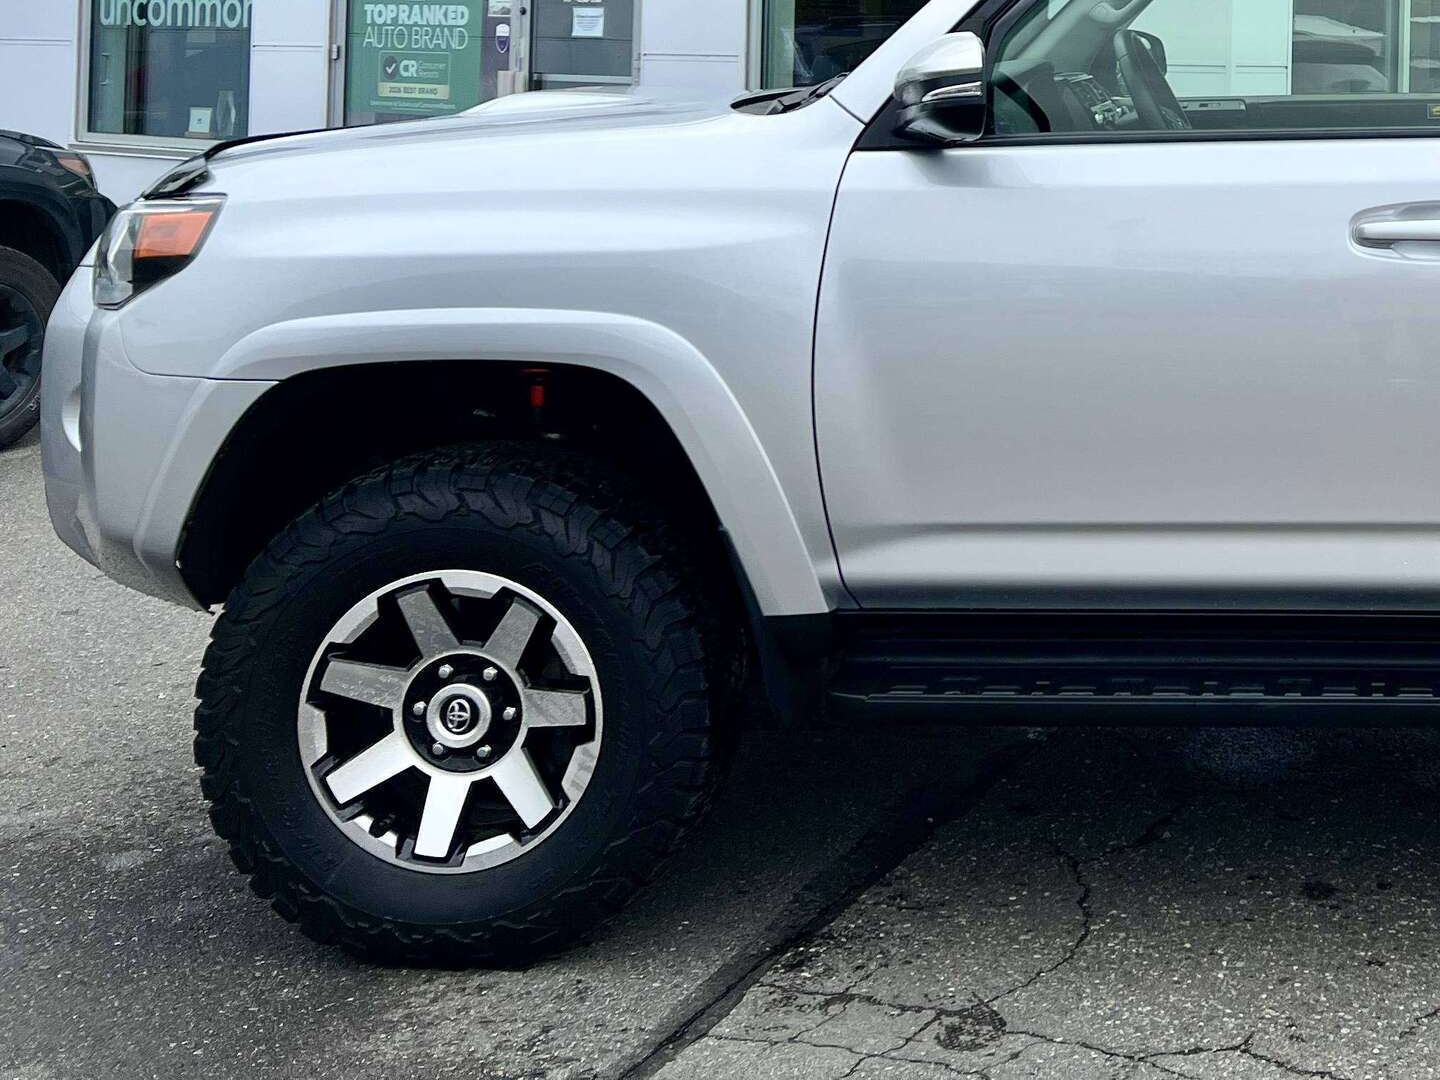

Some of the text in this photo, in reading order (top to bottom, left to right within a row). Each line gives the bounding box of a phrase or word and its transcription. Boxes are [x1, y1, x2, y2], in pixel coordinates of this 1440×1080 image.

[364, 4, 470, 26] TOP RANKED
[363, 26, 469, 49] AUTO BRAND
[400, 60, 417, 77] CR
